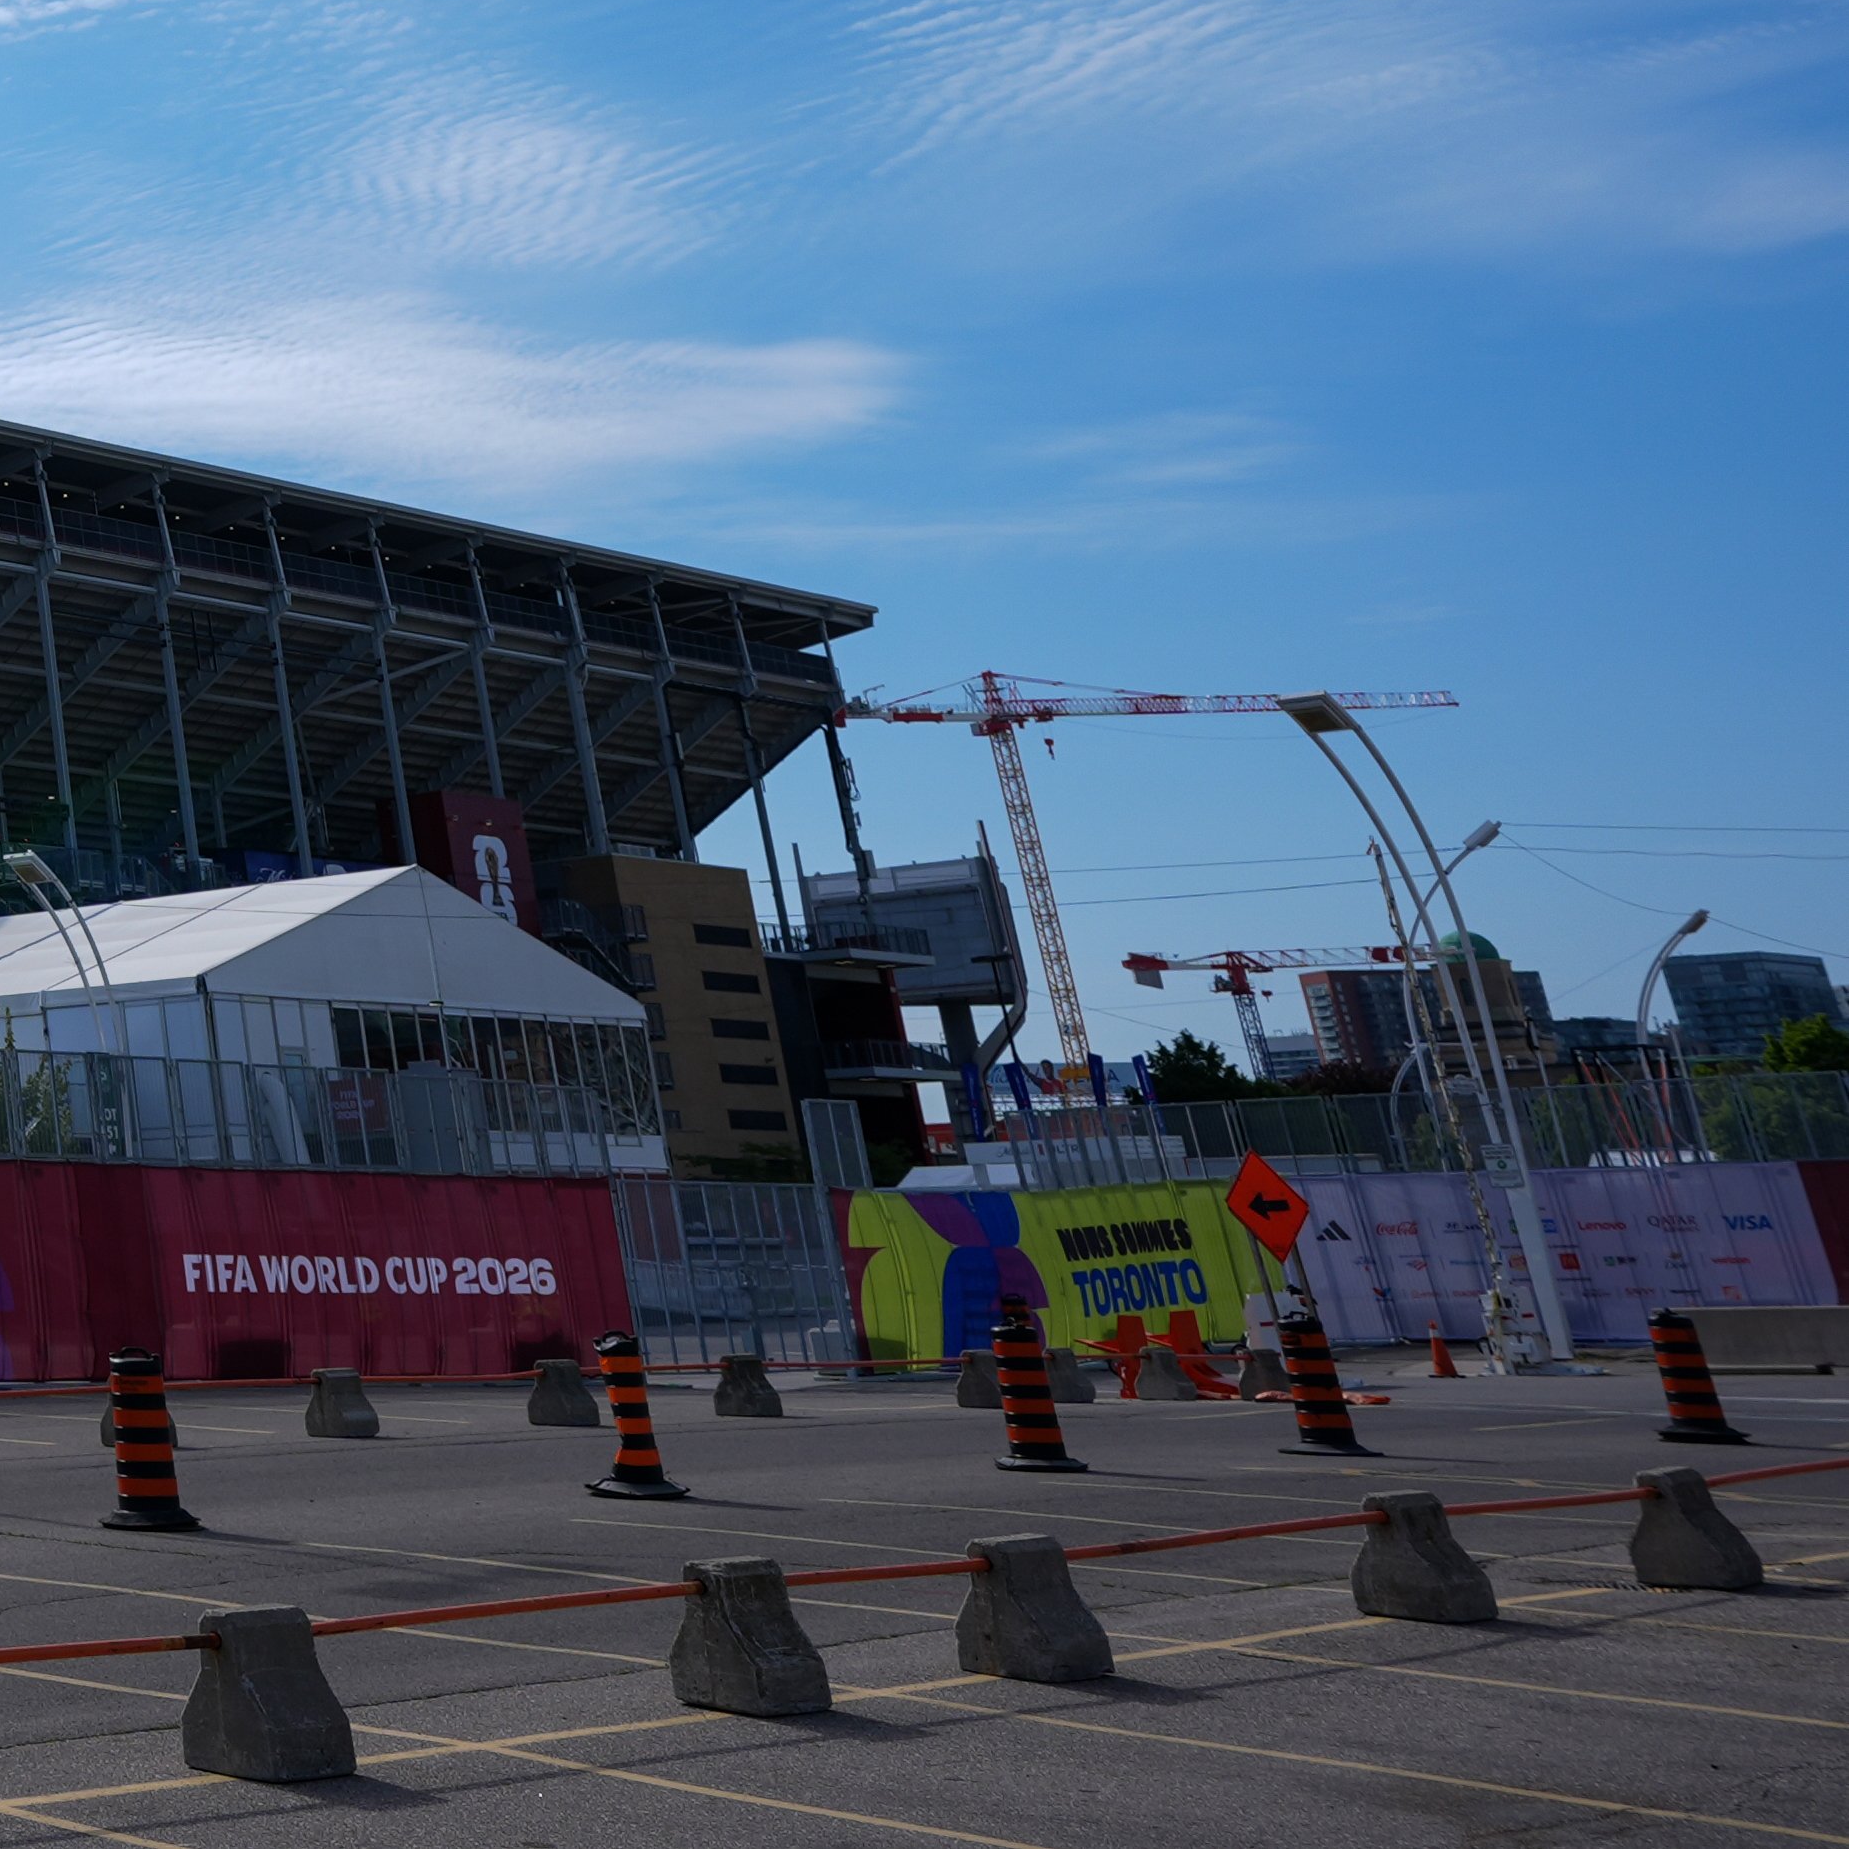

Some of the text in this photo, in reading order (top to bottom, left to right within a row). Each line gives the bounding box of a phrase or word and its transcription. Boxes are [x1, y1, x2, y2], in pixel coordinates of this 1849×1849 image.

[1110, 1218, 1193, 1255] SOMMES
[1578, 1220, 1627, 1232] Lenovo
[1722, 1215, 1774, 1231] VISA
[183, 1254, 557, 1296] FIFA WORLD CUP 2026
[1071, 1258, 1208, 1318] TORONTO
